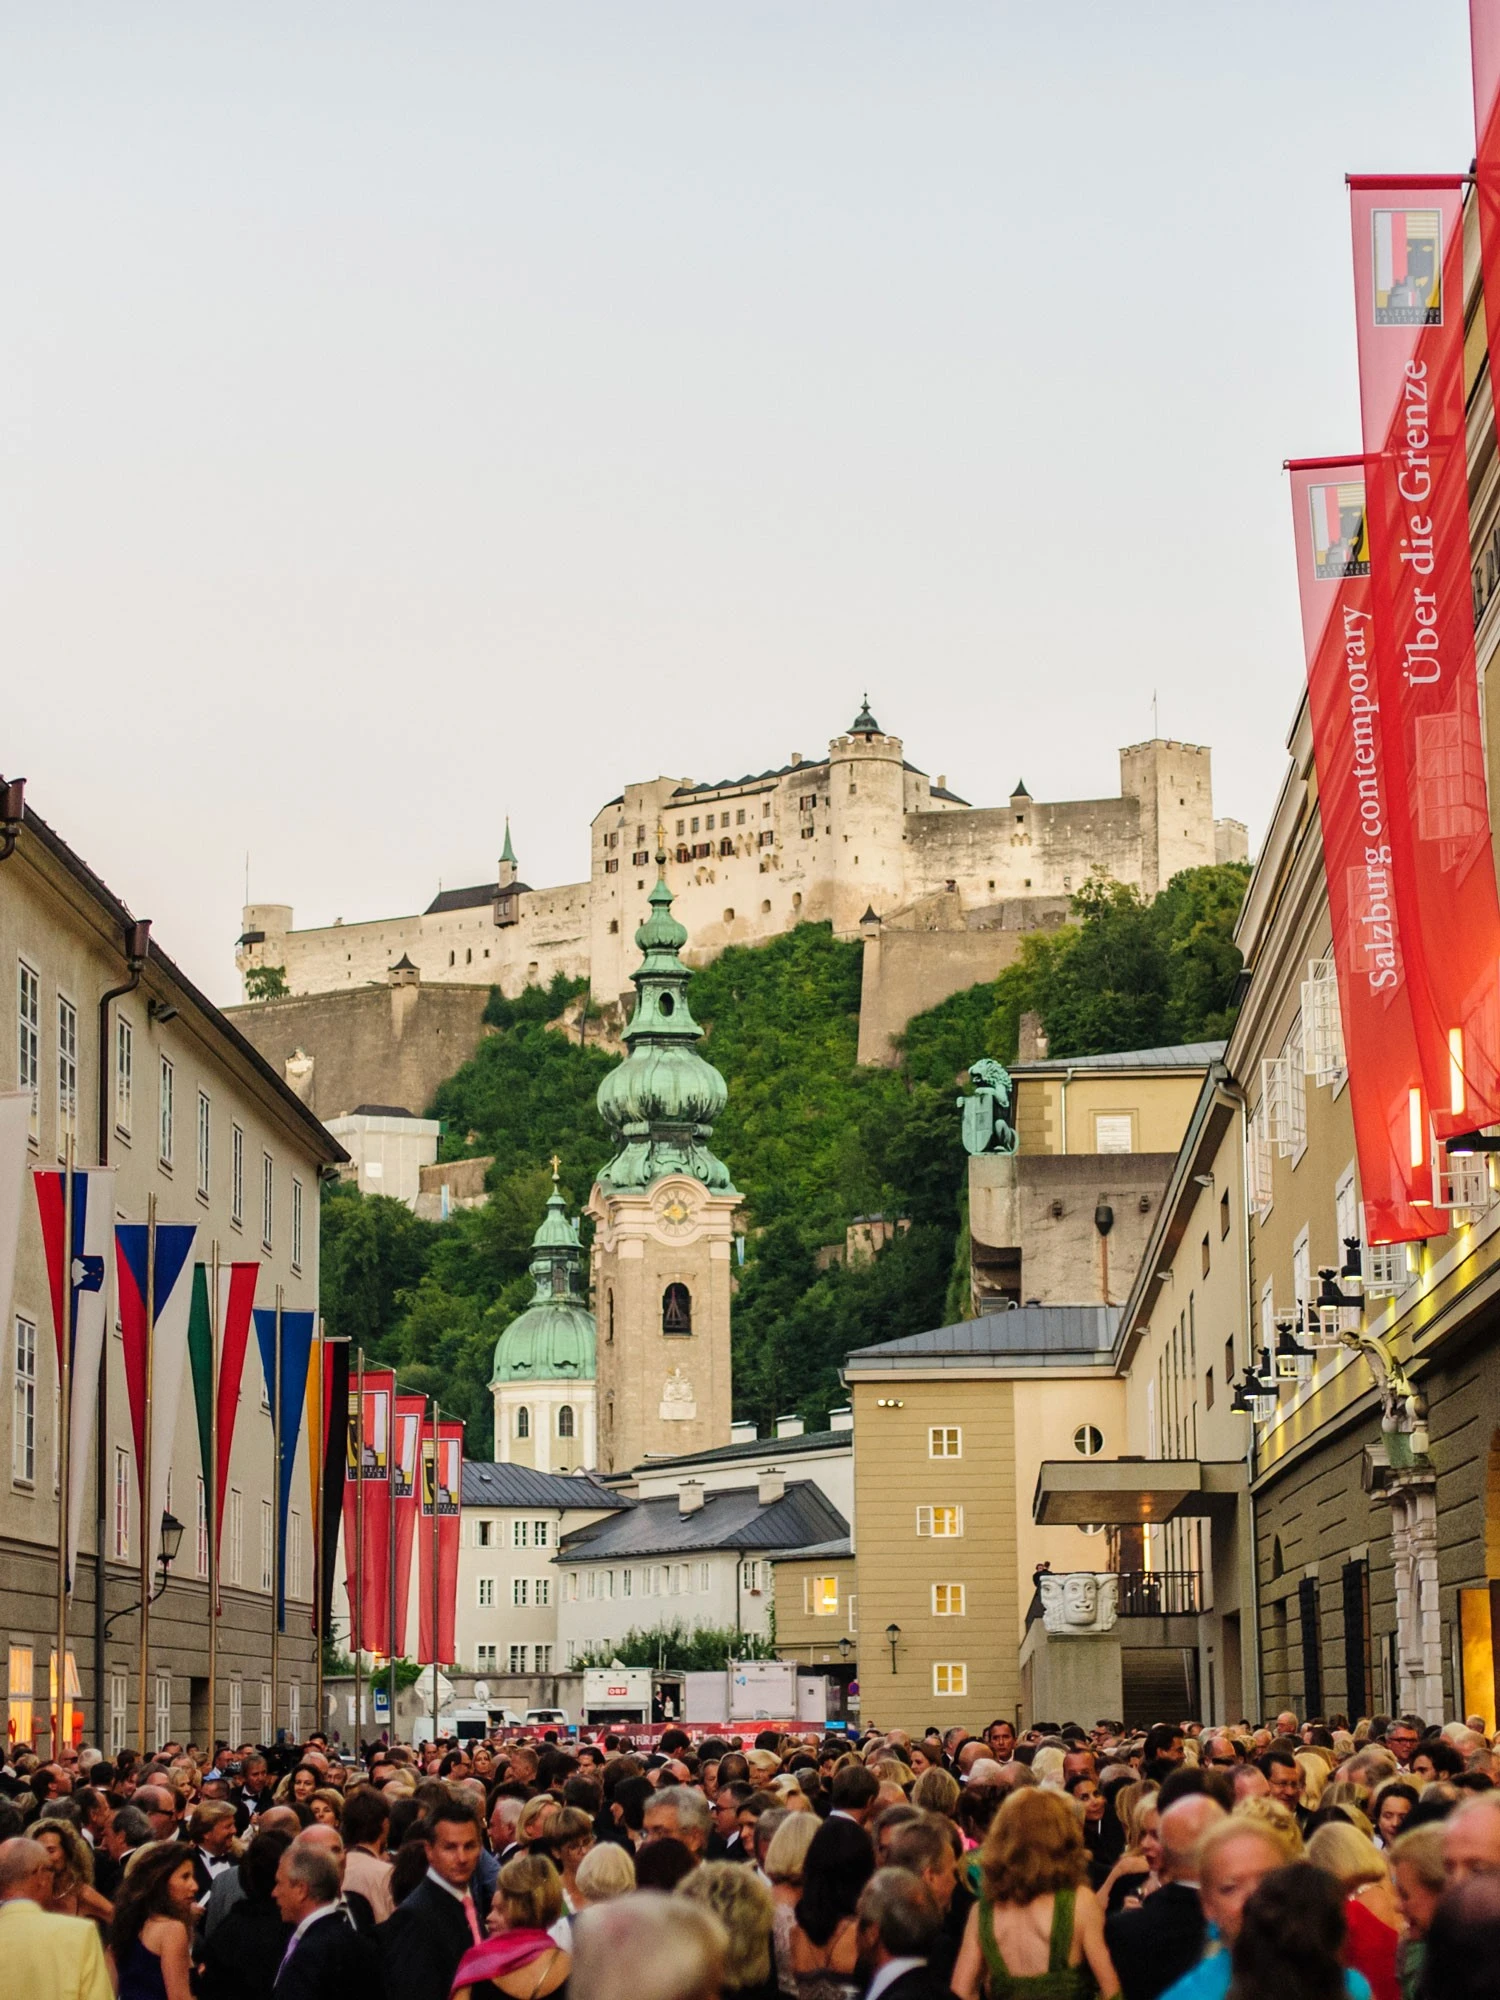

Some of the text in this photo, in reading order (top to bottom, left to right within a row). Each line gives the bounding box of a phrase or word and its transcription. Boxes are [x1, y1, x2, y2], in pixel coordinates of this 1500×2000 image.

[1398, 359, 1441, 688] Über die Grenze
[1343, 604, 1397, 988] Salzburg contemporary
